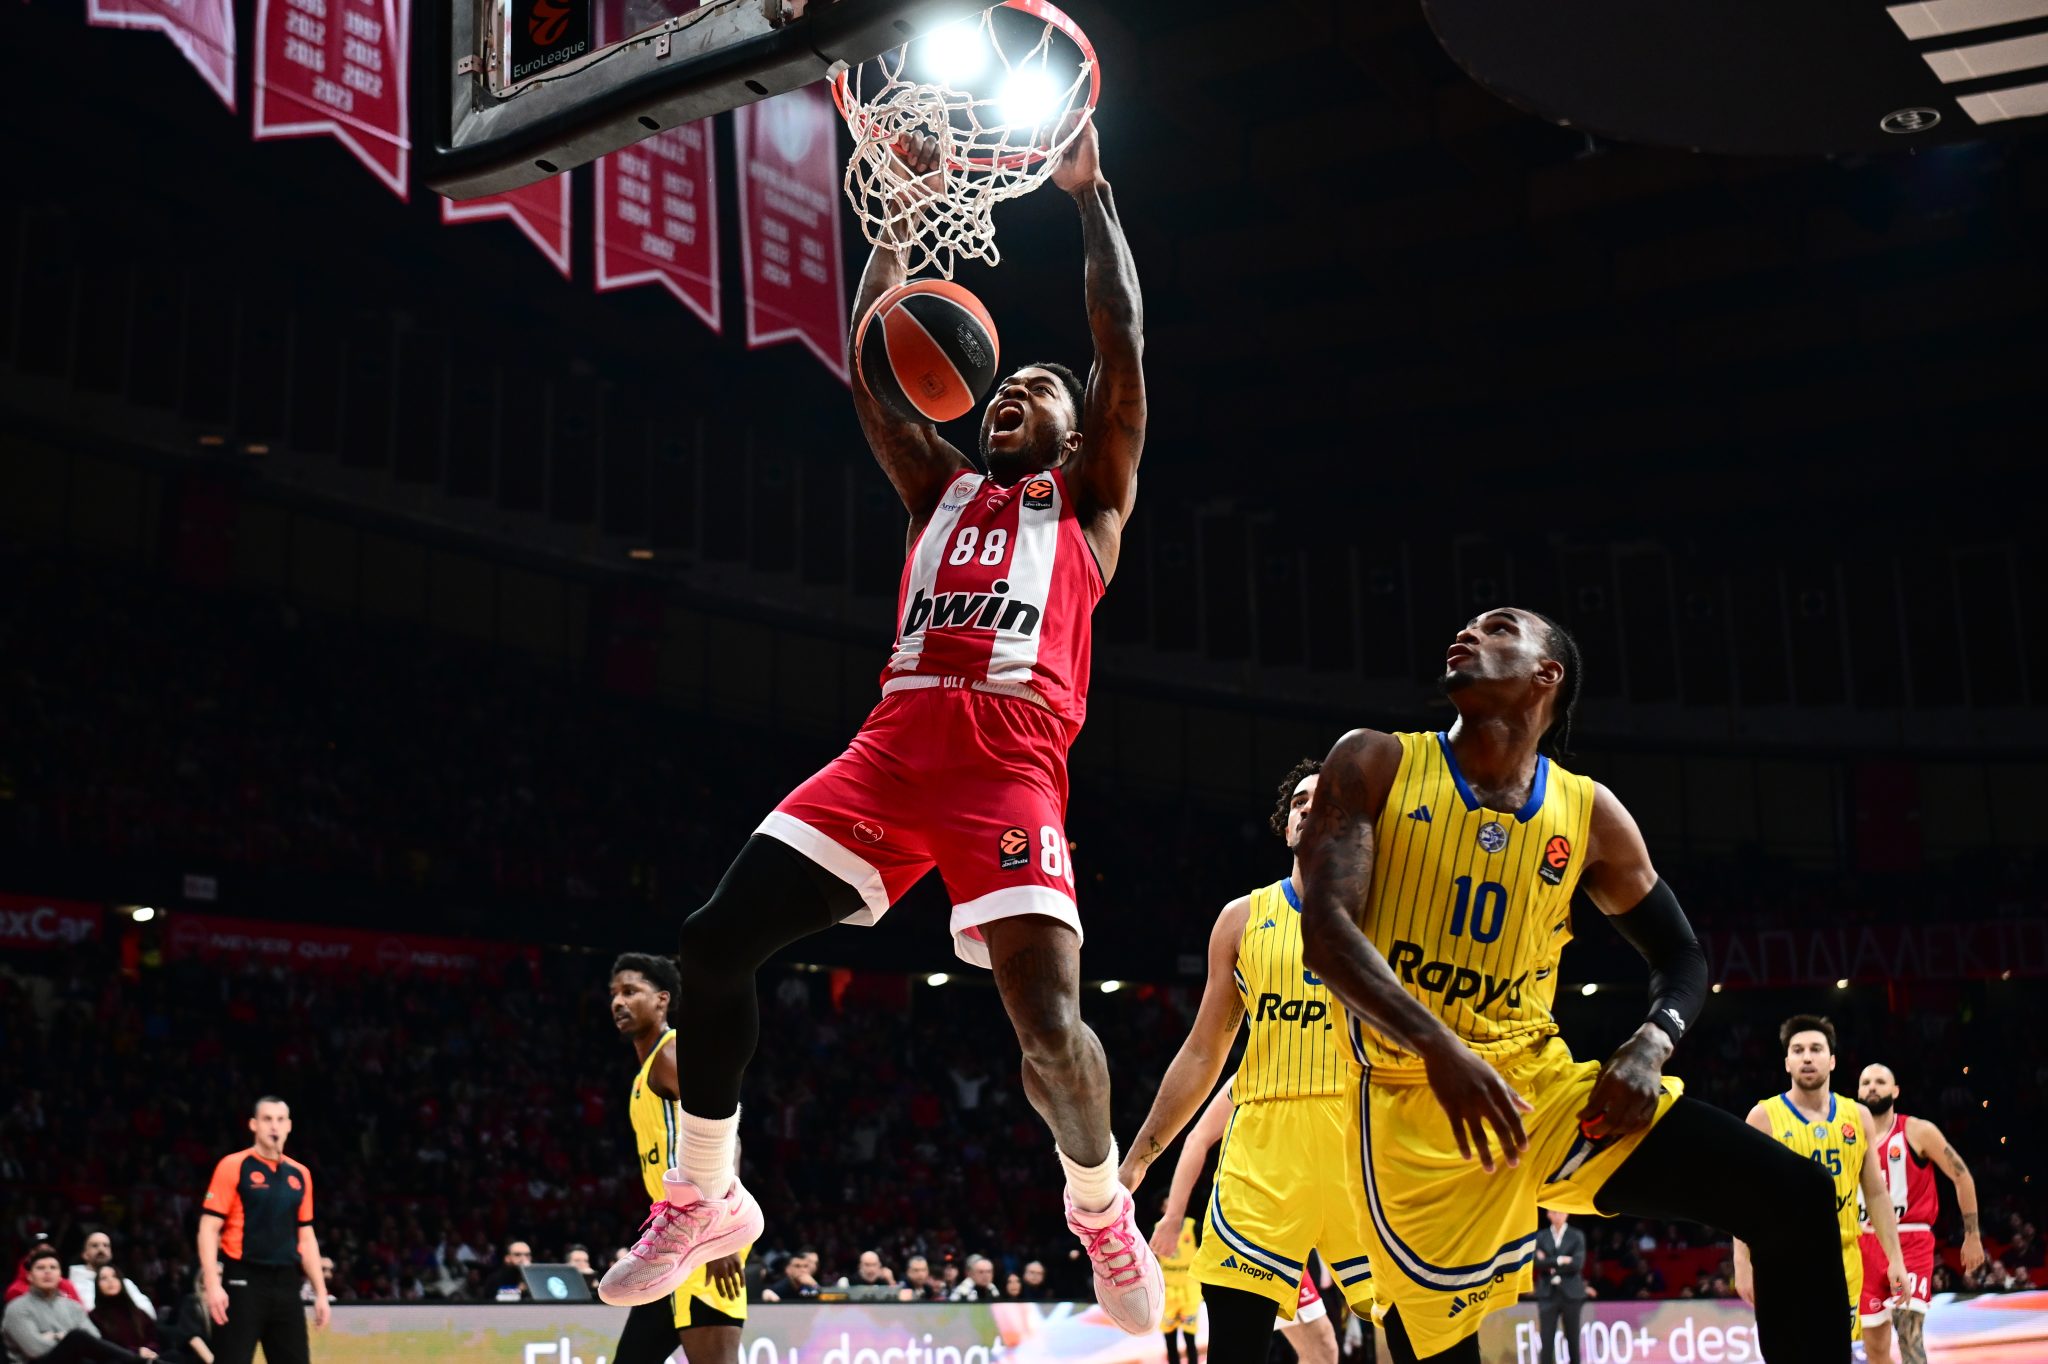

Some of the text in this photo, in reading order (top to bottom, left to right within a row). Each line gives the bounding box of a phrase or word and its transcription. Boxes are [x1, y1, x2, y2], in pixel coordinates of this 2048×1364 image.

[513, 41, 585, 78] EuroLeague
[949, 526, 1008, 566] 88
[902, 578, 1041, 637] bwin
[1450, 875, 1507, 943] 10
[211, 932, 291, 954] NEVER
[1256, 993, 1332, 1030] Rap
[1810, 1149, 1842, 1176] 45
[1239, 1263, 1274, 1281] Rapyd
